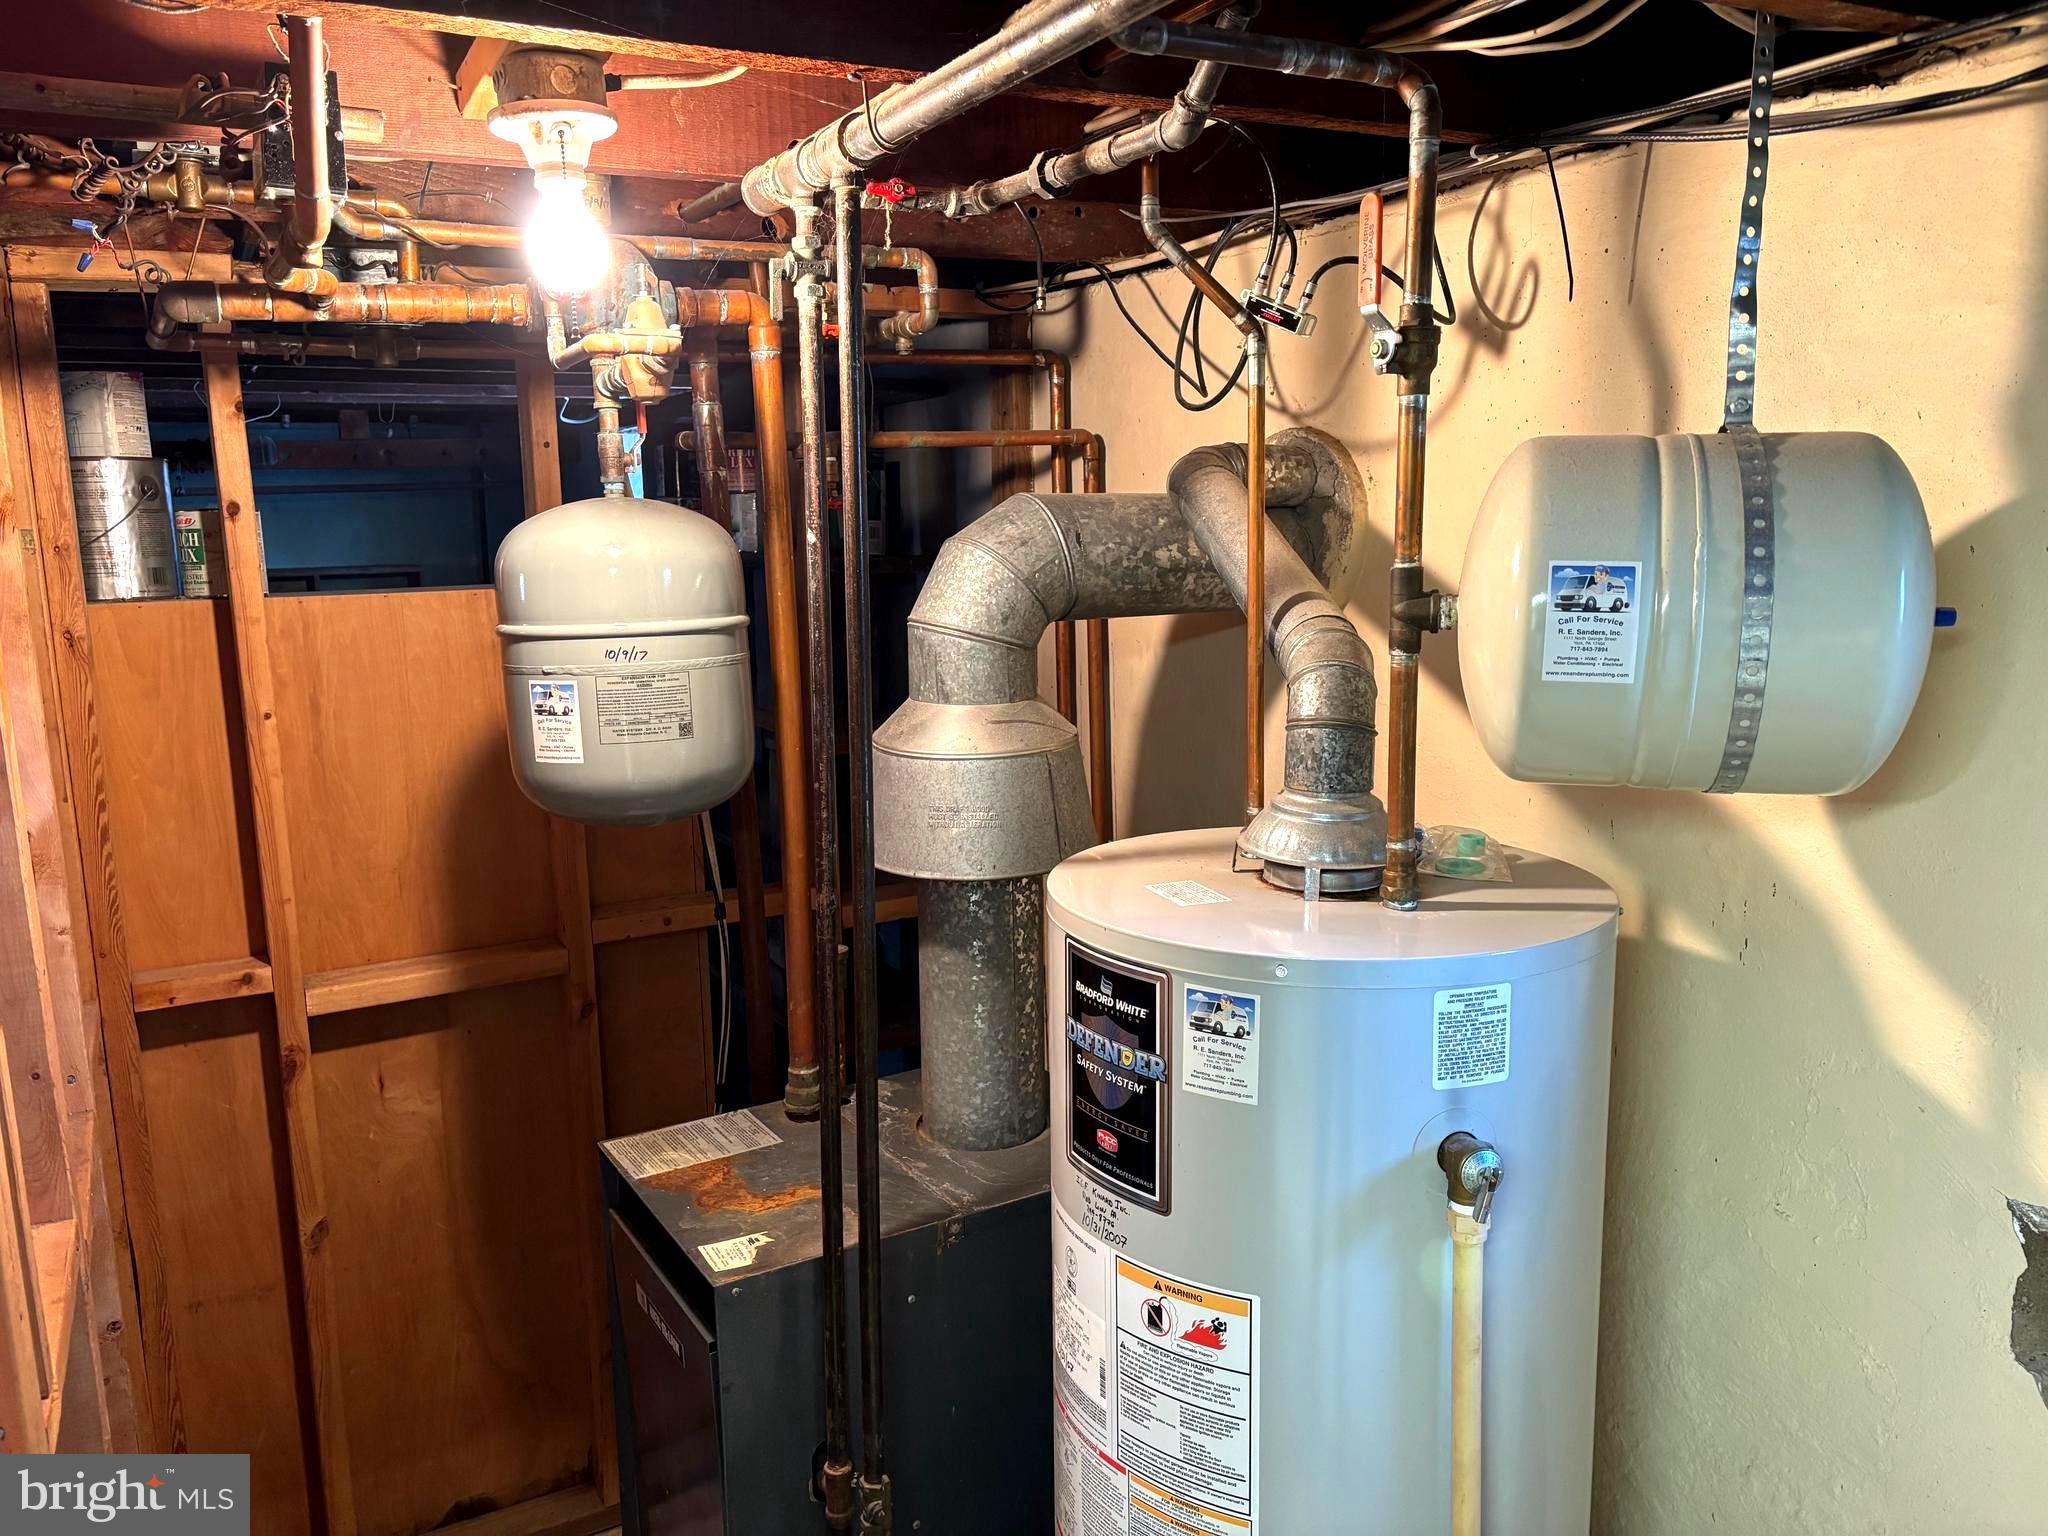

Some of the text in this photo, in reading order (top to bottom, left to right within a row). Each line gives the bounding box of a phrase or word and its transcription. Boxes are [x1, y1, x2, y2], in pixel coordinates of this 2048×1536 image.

[1558, 616, 1574, 625] Call
[1593, 616, 1624, 627] Service
[605, 646, 648, 662] 10/9/17
[1546, 670, 1630, 678] www.resandersplumbing.com
[1076, 980, 1147, 1018] BRADFORD WHITE
[1067, 1015, 1168, 1083] DEFENDER
[1208, 1048, 1234, 1058] Sanders,
[1220, 1039, 1246, 1051] Service
[1076, 1054, 1144, 1094] SAFETY SYSTEM
[1185, 1082, 1254, 1099] www.resandersplumbing.com
[1076, 1098, 1148, 1139] ENERGY SAVER
[1074, 1140, 1092, 1159] PRODUCTS
[1103, 1160, 1112, 1170] FOR
[1113, 1166, 1153, 1189] PROFESSIONALS
[1082, 1213, 1128, 1248] 10/31/2007
[1164, 1284, 1203, 1303] WARNING
[1137, 1340, 1214, 1375] FIRE AND EXPLOSION HAZARD
[1176, 1343, 1213, 1358] Flammable Vapors
[1175, 1496, 1200, 1512] WARNING
